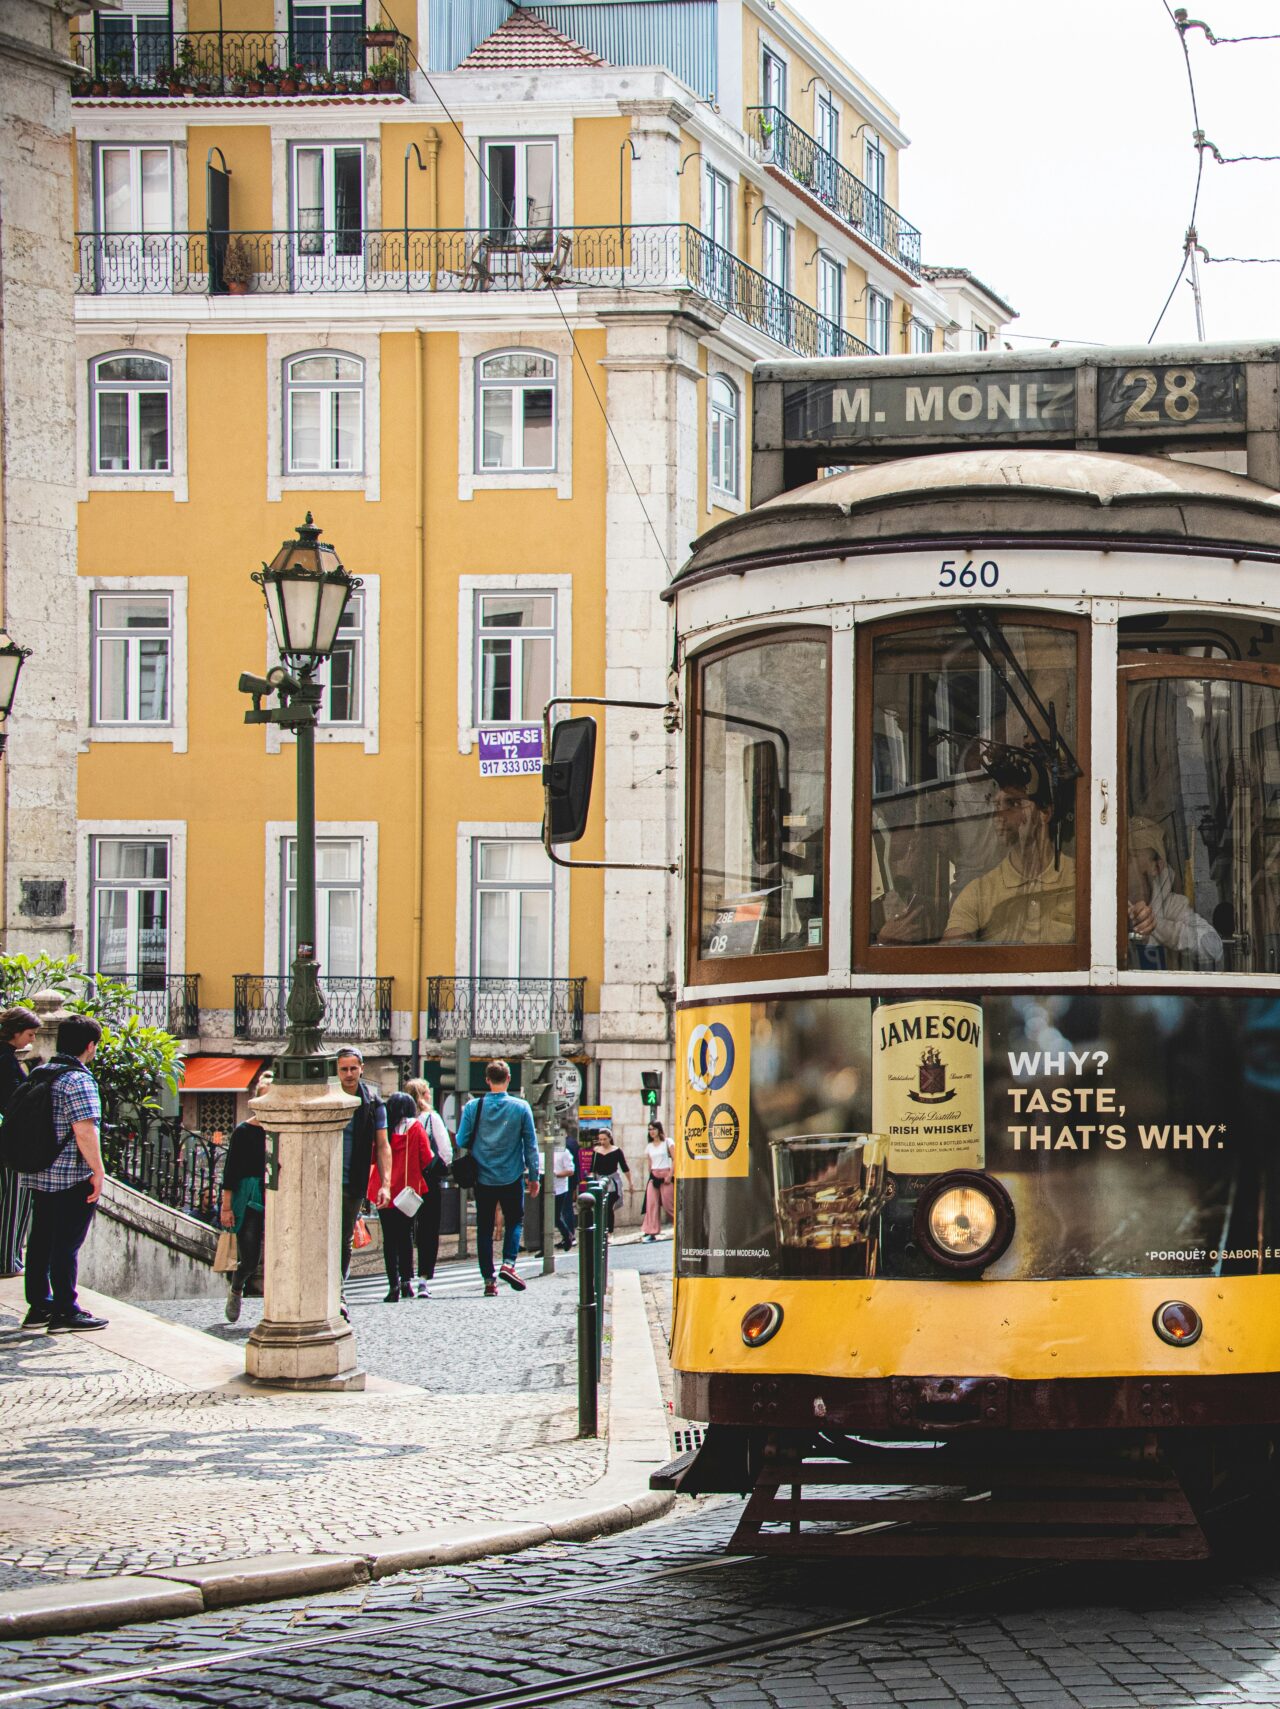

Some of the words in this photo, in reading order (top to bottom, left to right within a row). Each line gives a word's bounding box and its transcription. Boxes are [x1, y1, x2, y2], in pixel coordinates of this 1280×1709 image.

[832, 388, 886, 424] M.
[905, 383, 1074, 422] MONIZ
[1123, 367, 1201, 423] 28
[938, 560, 999, 588] 560
[481, 729, 539, 746] VENDE-SE
[502, 745, 518, 758] T2
[481, 761, 499, 774] 917
[502, 760, 520, 773] 333
[522, 759, 541, 772] 035
[716, 911, 734, 924] 28E
[709, 935, 728, 953] 08
[880, 1015, 981, 1051] JAMESON
[1008, 1051, 1109, 1076] WHY?
[1007, 1088, 1126, 1117] TASTE,
[900, 1111, 927, 1125] Triple
[927, 1111, 962, 1121] Distilled
[889, 1126, 919, 1135] IRISH
[923, 1124, 973, 1134] WHISKEY
[1007, 1125, 1127, 1150] THAT'S
[1209, 1250, 1218, 1260] O
[1264, 1246, 1272, 1258] É
